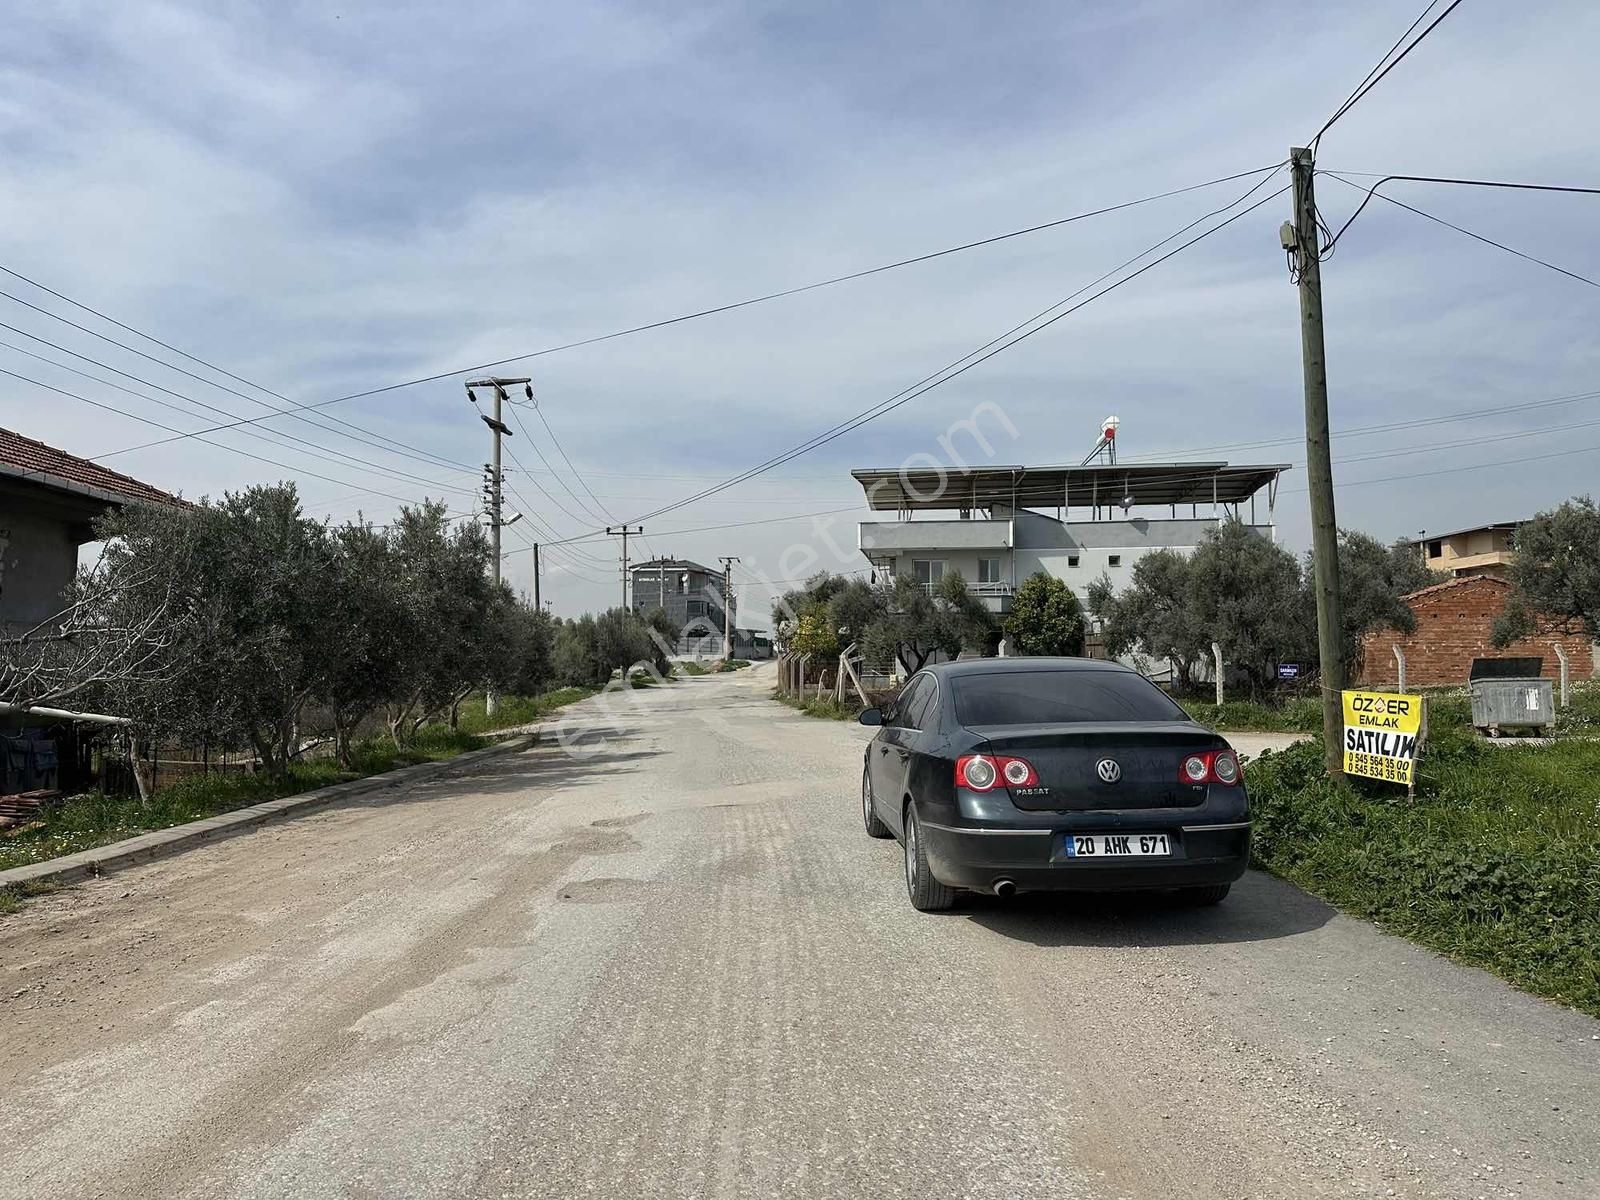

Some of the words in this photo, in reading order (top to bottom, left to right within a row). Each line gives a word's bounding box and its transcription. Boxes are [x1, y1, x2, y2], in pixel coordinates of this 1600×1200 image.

[1359, 714, 1399, 728] EMLAK
[1346, 728, 1415, 759] SATILIK
[1348, 752, 1354, 762] 0
[1355, 753, 1368, 765] 545
[1369, 755, 1383, 767] 564
[1384, 758, 1395, 769] 35
[1396, 760, 1410, 771] 00
[1348, 763, 1353, 772] 0
[1354, 764, 1368, 775] 545
[1369, 766, 1383, 778] 534
[1385, 769, 1395, 780] 35
[1396, 771, 1407, 782] 00
[1016, 788, 1049, 796] PASSAT
[1075, 837, 1095, 855] 20
[1104, 836, 1132, 854] AHK
[1139, 835, 1167, 854] 671
